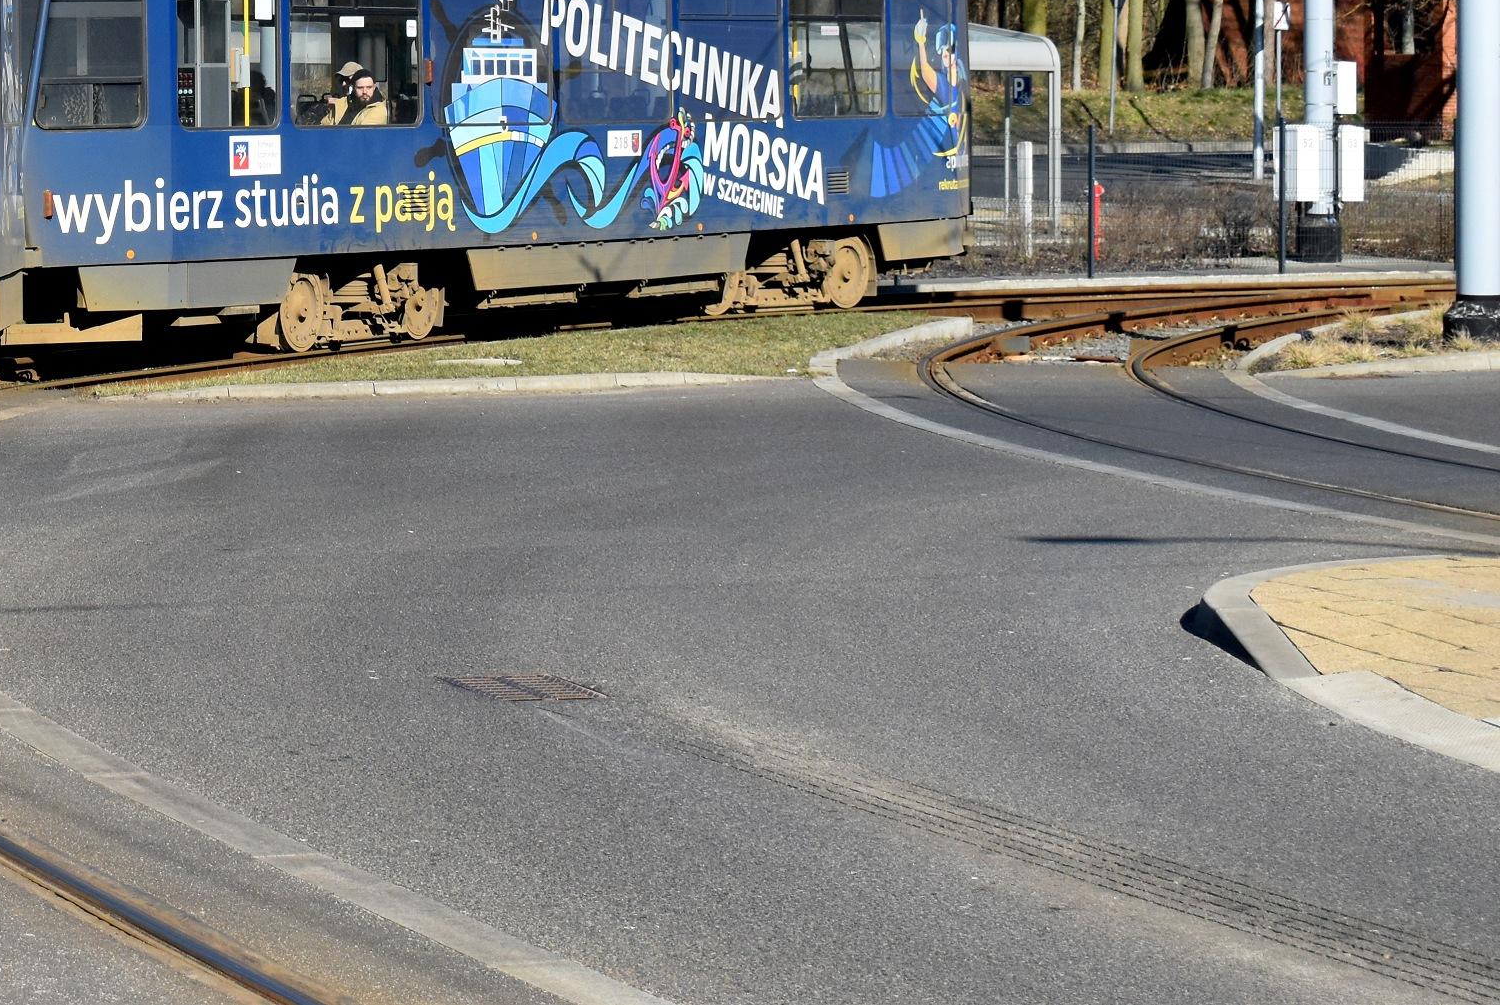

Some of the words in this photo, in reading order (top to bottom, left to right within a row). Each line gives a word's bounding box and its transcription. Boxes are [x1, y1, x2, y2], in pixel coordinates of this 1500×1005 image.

[1013, 77, 1025, 99] P
[613, 136, 629, 149] 218
[703, 112, 825, 205] MORSKA
[52, 177, 224, 245] wybierz
[234, 173, 339, 229] studia
[349, 185, 365, 224] z
[703, 172, 717, 197] W
[717, 180, 785, 219] SZCZECINIE
